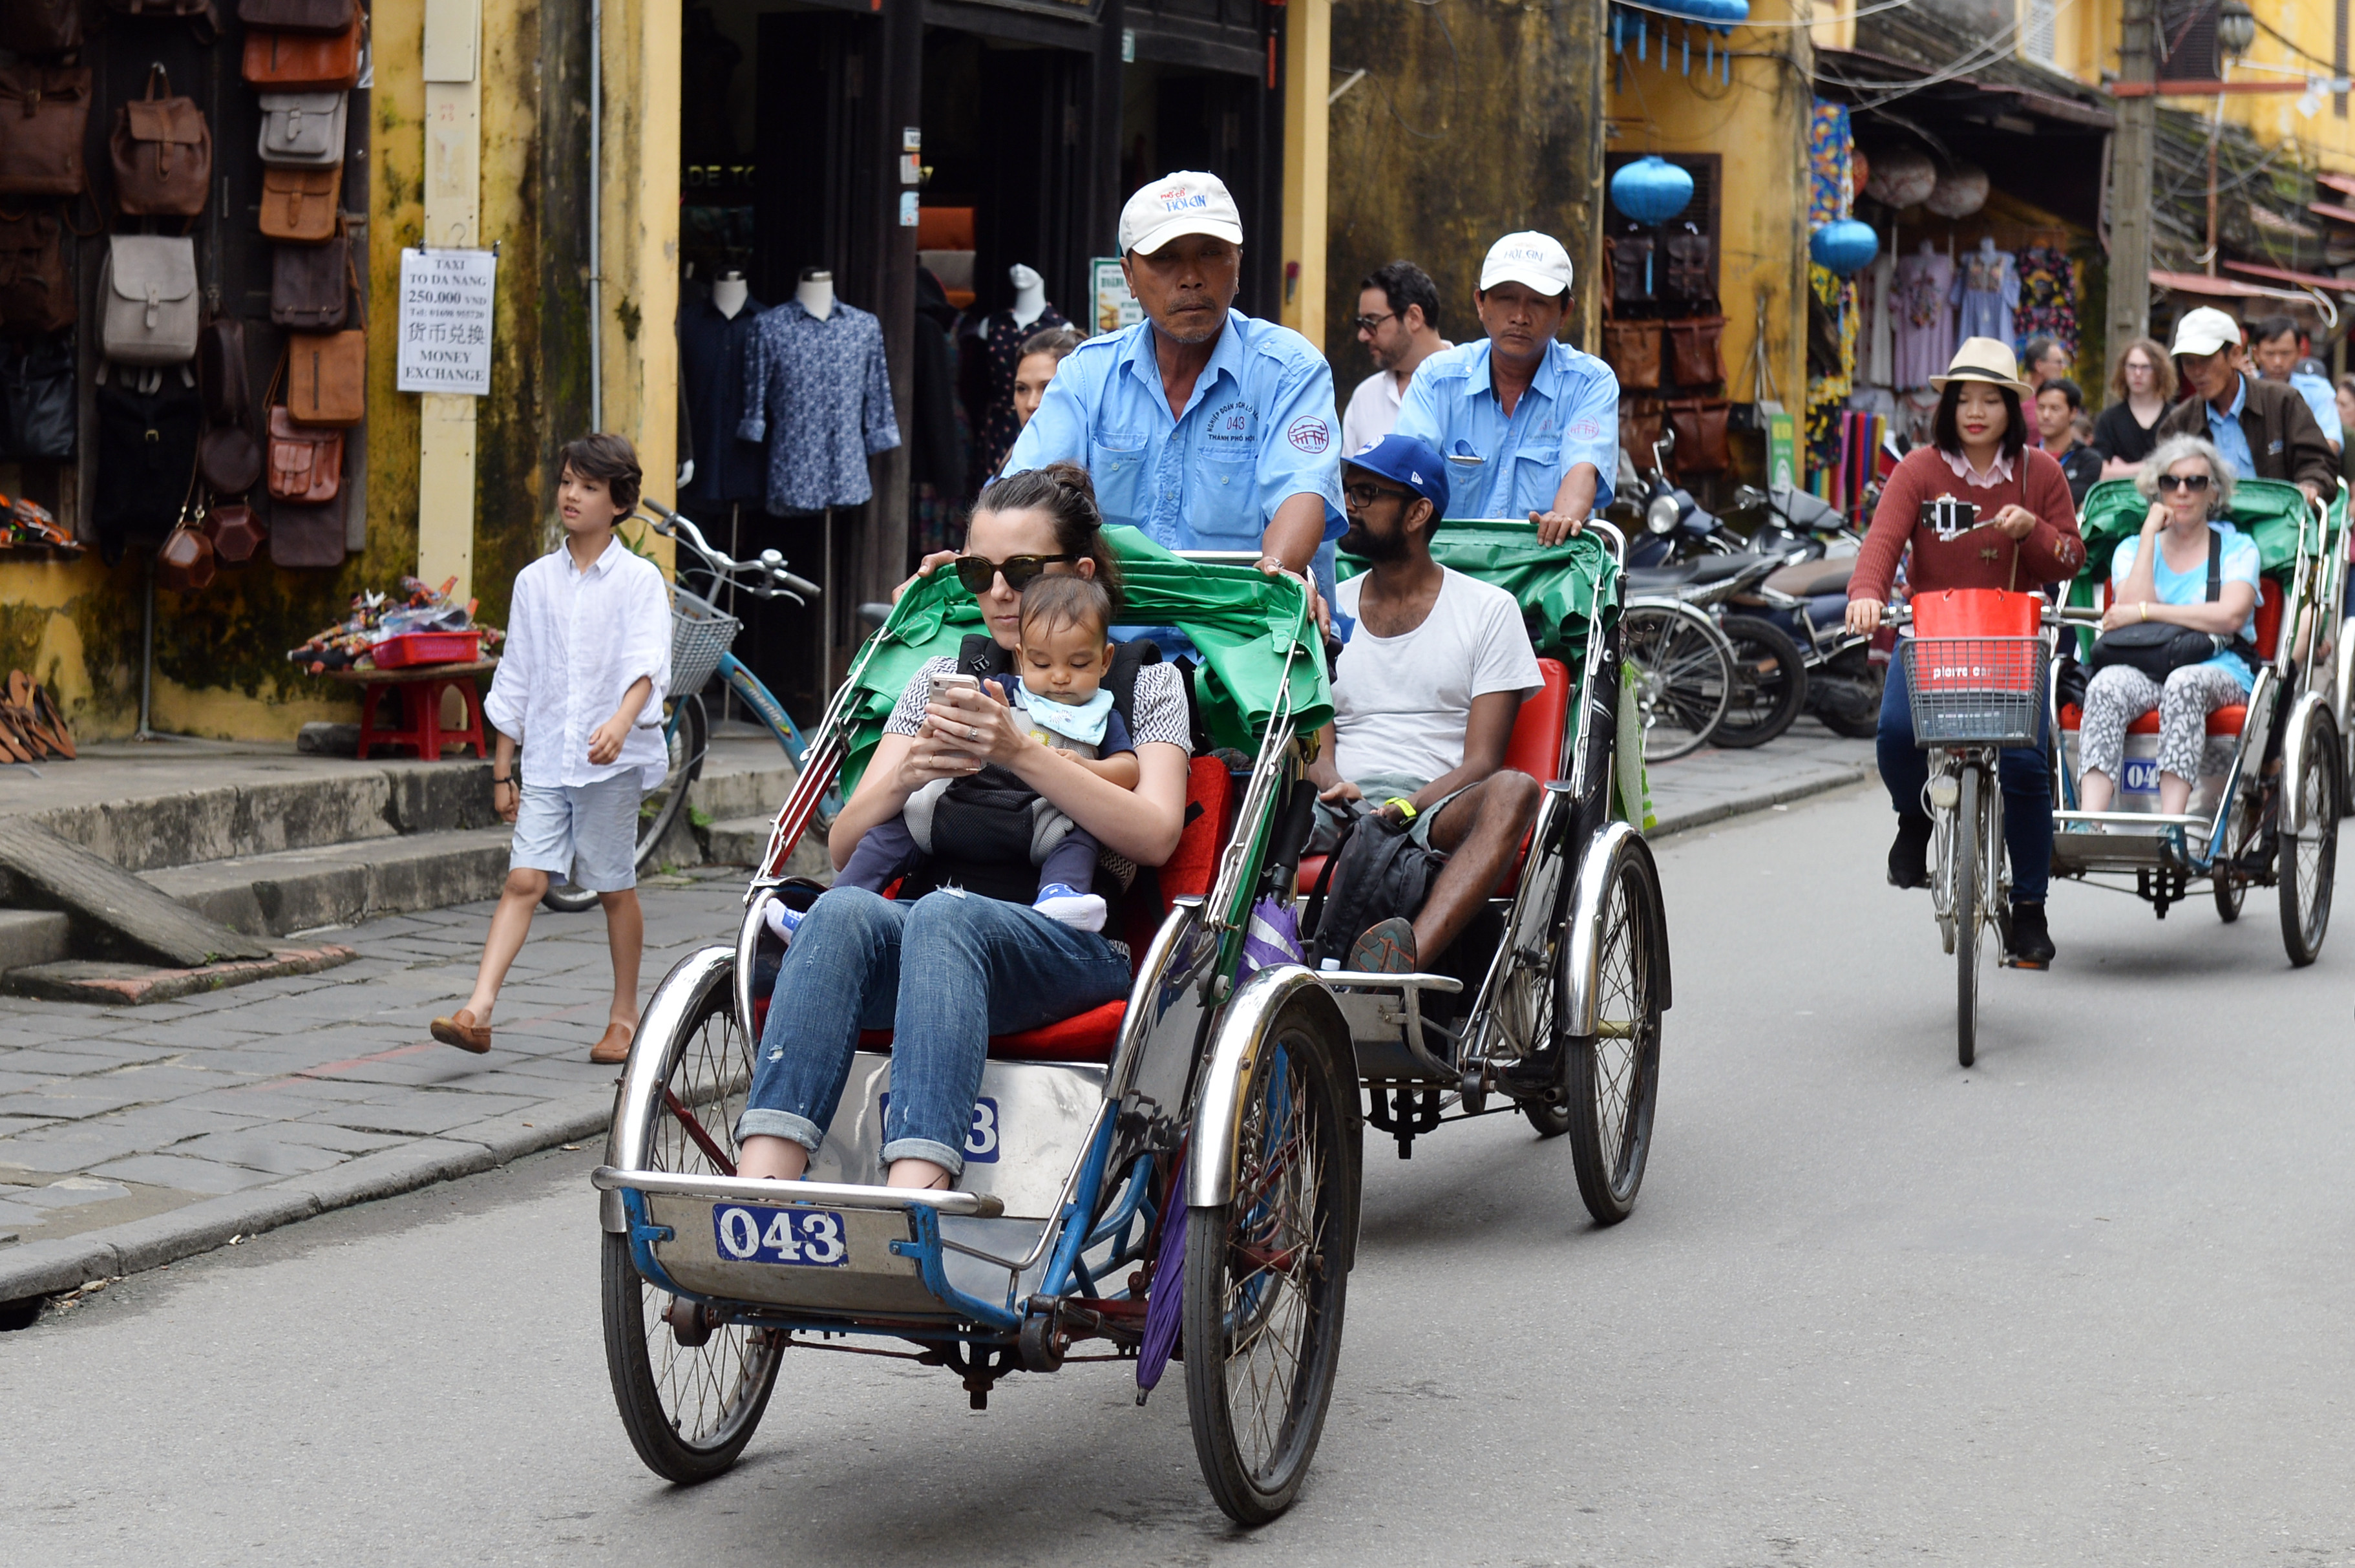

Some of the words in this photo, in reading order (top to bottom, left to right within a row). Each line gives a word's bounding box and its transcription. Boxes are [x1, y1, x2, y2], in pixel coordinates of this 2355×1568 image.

[1189, 195, 1207, 207] AN
[435, 259, 465, 271] TAXI
[410, 274, 428, 284] TO
[432, 275, 449, 285] DA
[453, 276, 487, 286] NANG
[408, 290, 461, 304] 250.000
[464, 297, 487, 306] VND
[408, 322, 485, 345] 货币兑换
[420, 350, 472, 364] MONEY
[406, 366, 485, 382] EXCHANGE
[1227, 416, 1245, 430] 043
[2127, 764, 2157, 789] 04
[720, 1207, 845, 1264] 043
